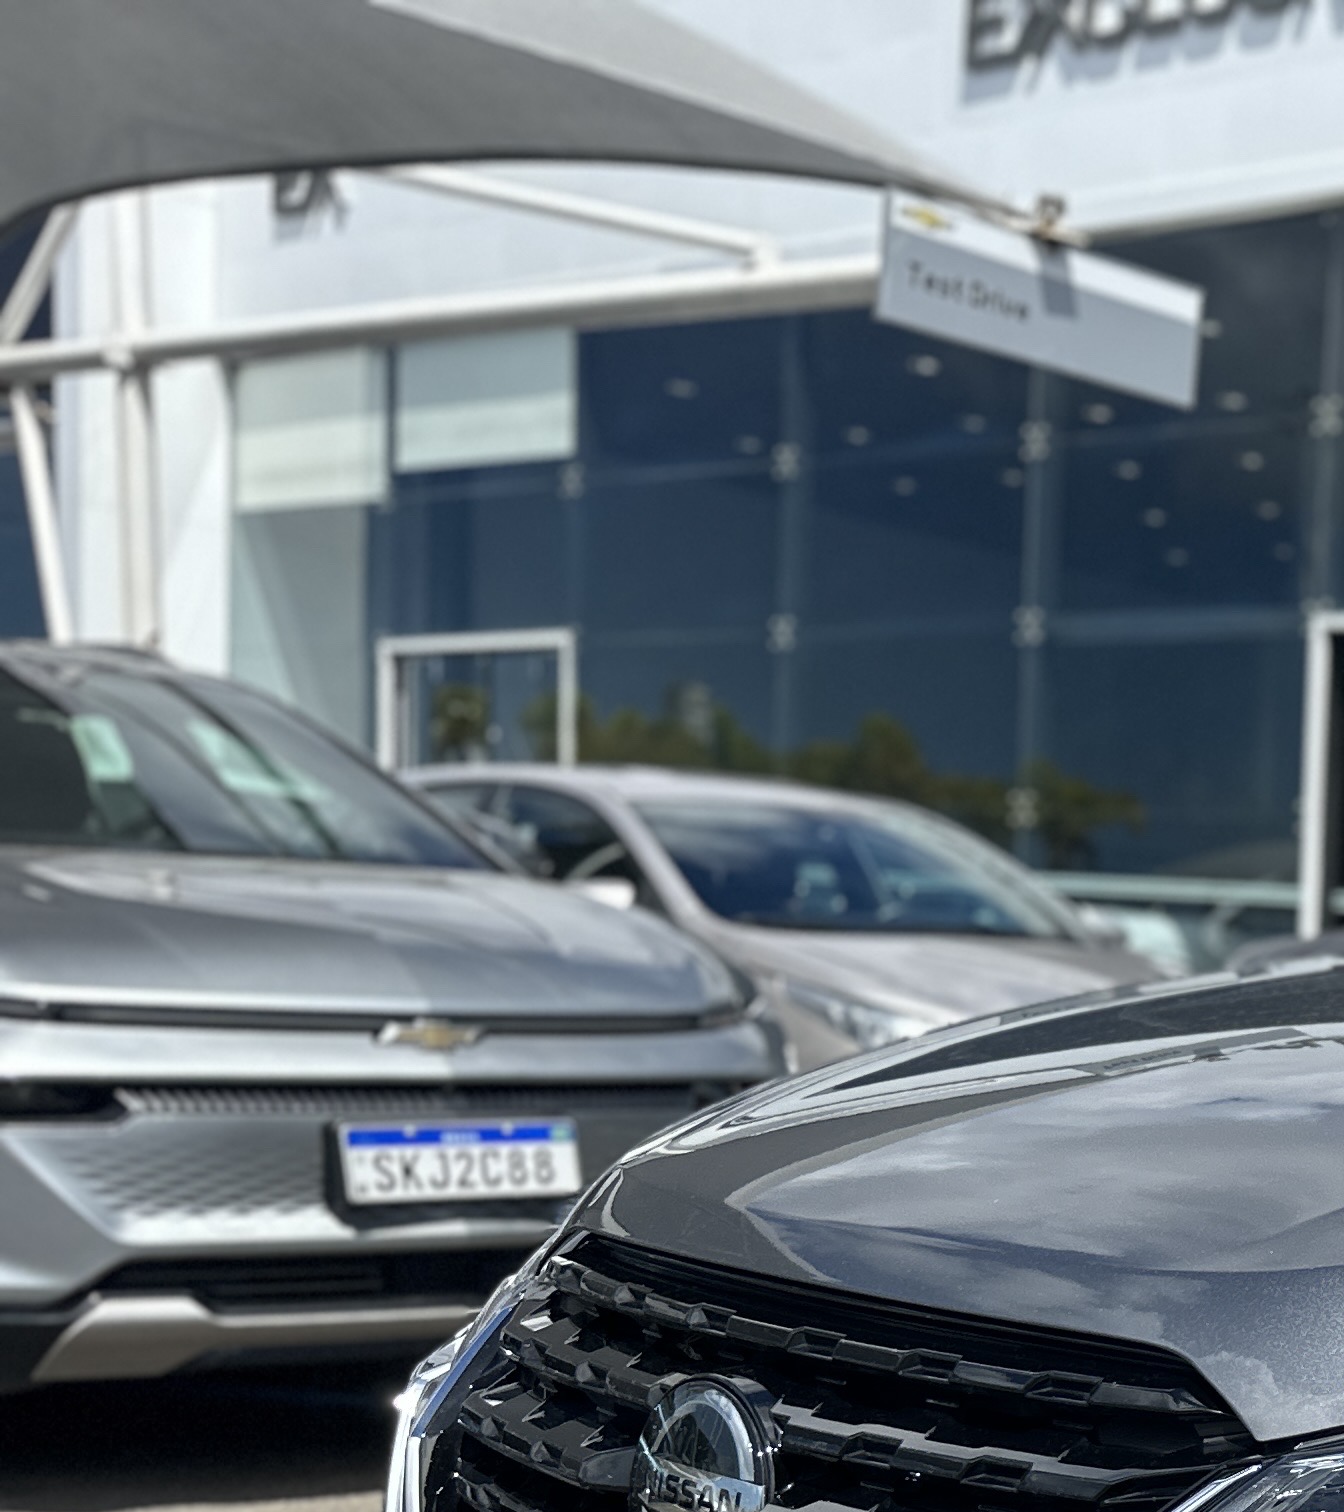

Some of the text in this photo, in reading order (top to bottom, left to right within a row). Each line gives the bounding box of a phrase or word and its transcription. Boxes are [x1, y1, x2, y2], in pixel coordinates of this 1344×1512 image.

[906, 257, 1030, 321] Test Drive
[371, 1147, 556, 1193] SKJ2C88
